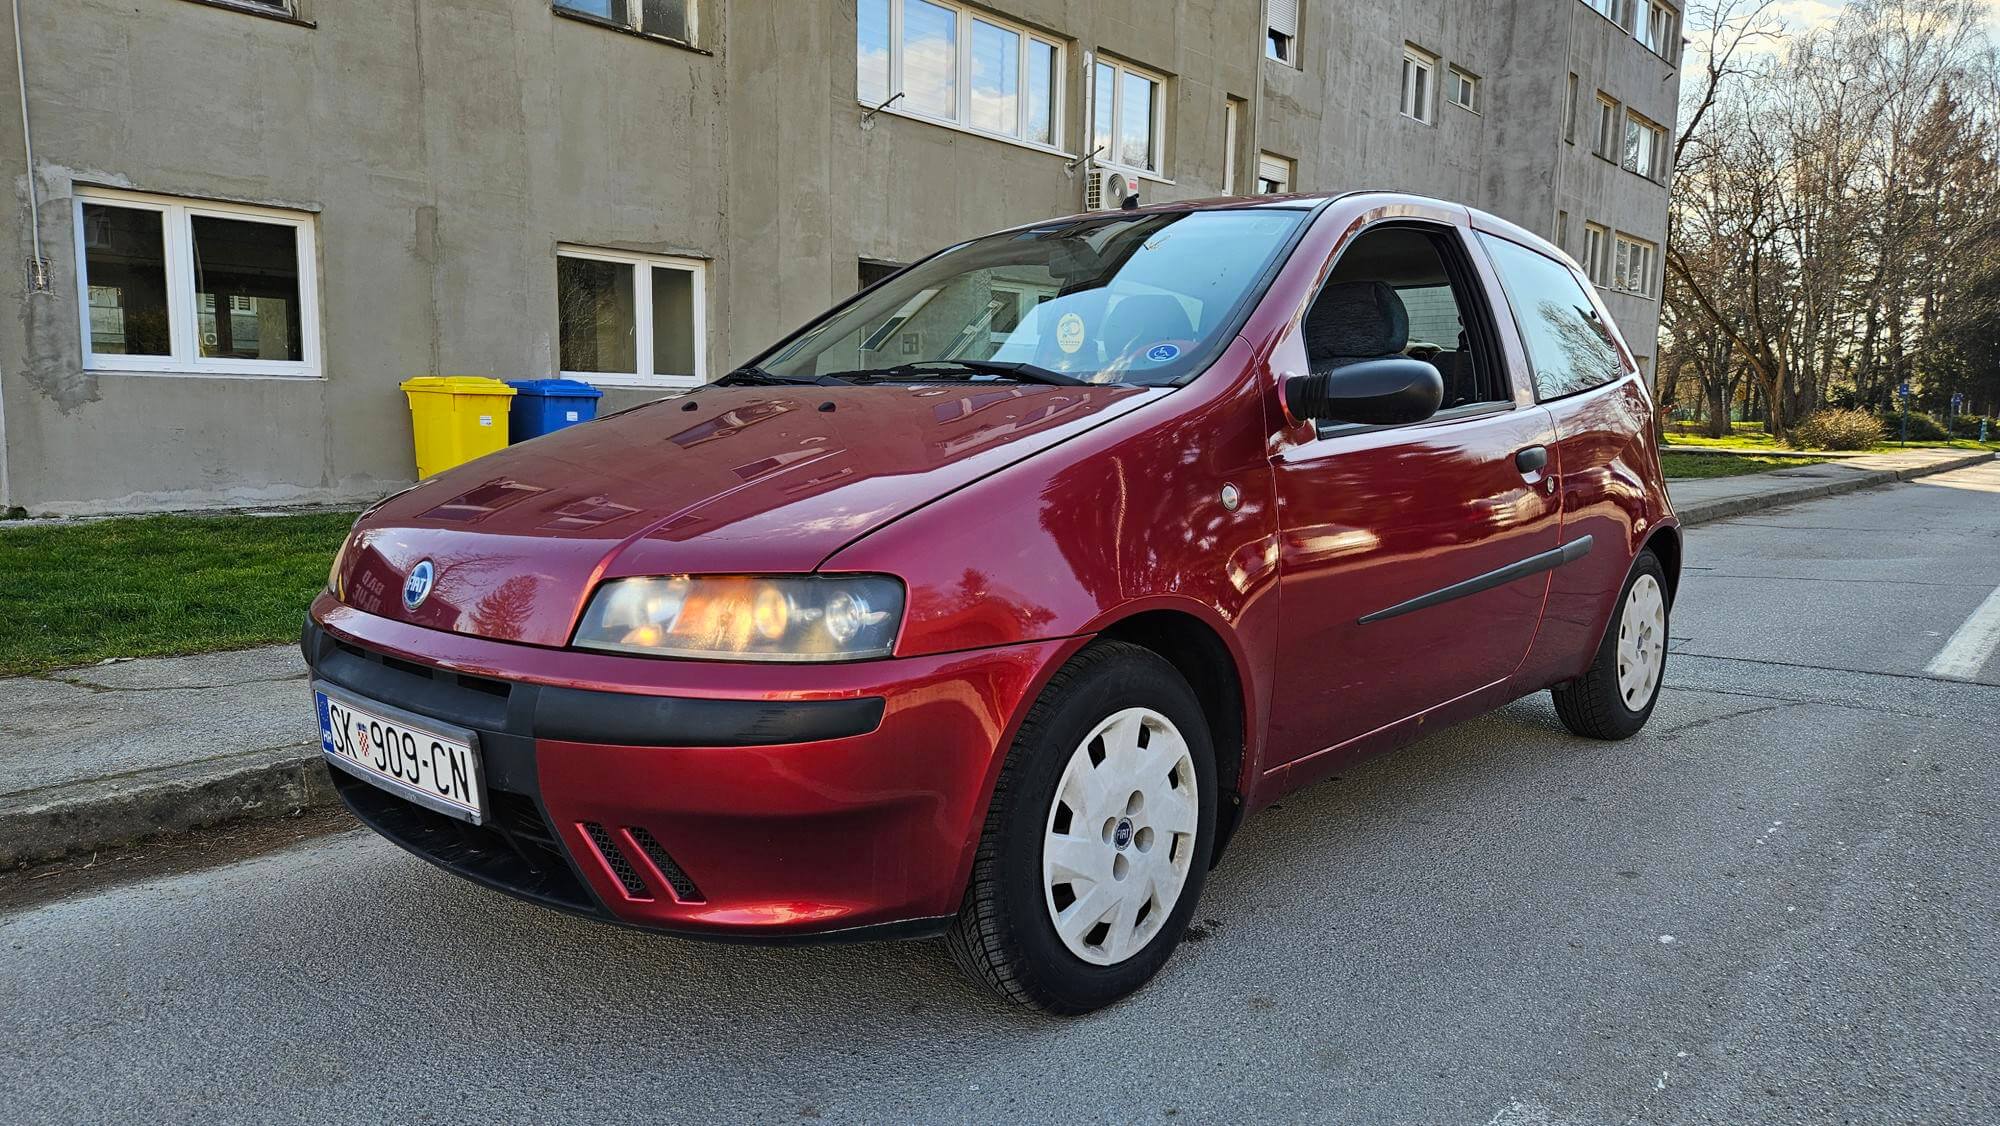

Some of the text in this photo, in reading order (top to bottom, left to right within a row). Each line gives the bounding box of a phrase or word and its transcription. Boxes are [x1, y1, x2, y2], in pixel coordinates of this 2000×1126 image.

[408, 575, 427, 593] FIAT
[330, 704, 471, 803] SK 909-CN
[1117, 828, 1129, 840] FIAT
